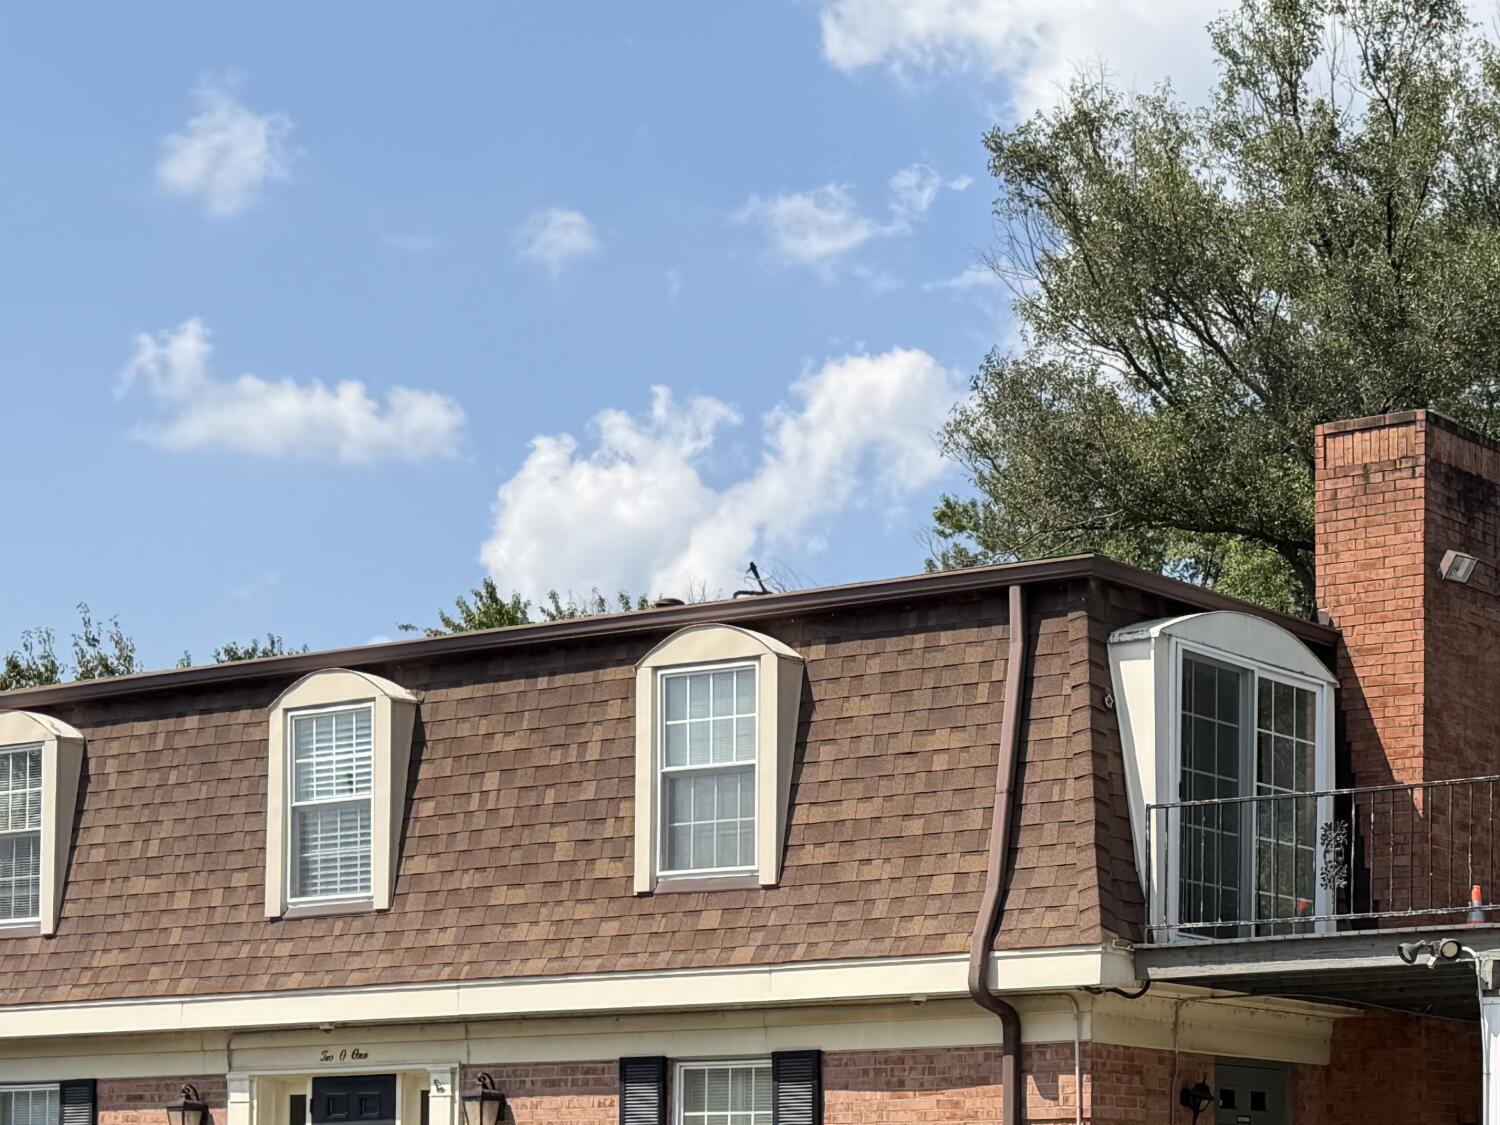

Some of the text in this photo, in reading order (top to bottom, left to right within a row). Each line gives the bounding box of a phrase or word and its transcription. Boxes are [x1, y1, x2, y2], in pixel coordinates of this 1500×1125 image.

[320, 1048, 369, 1061] Two O One
